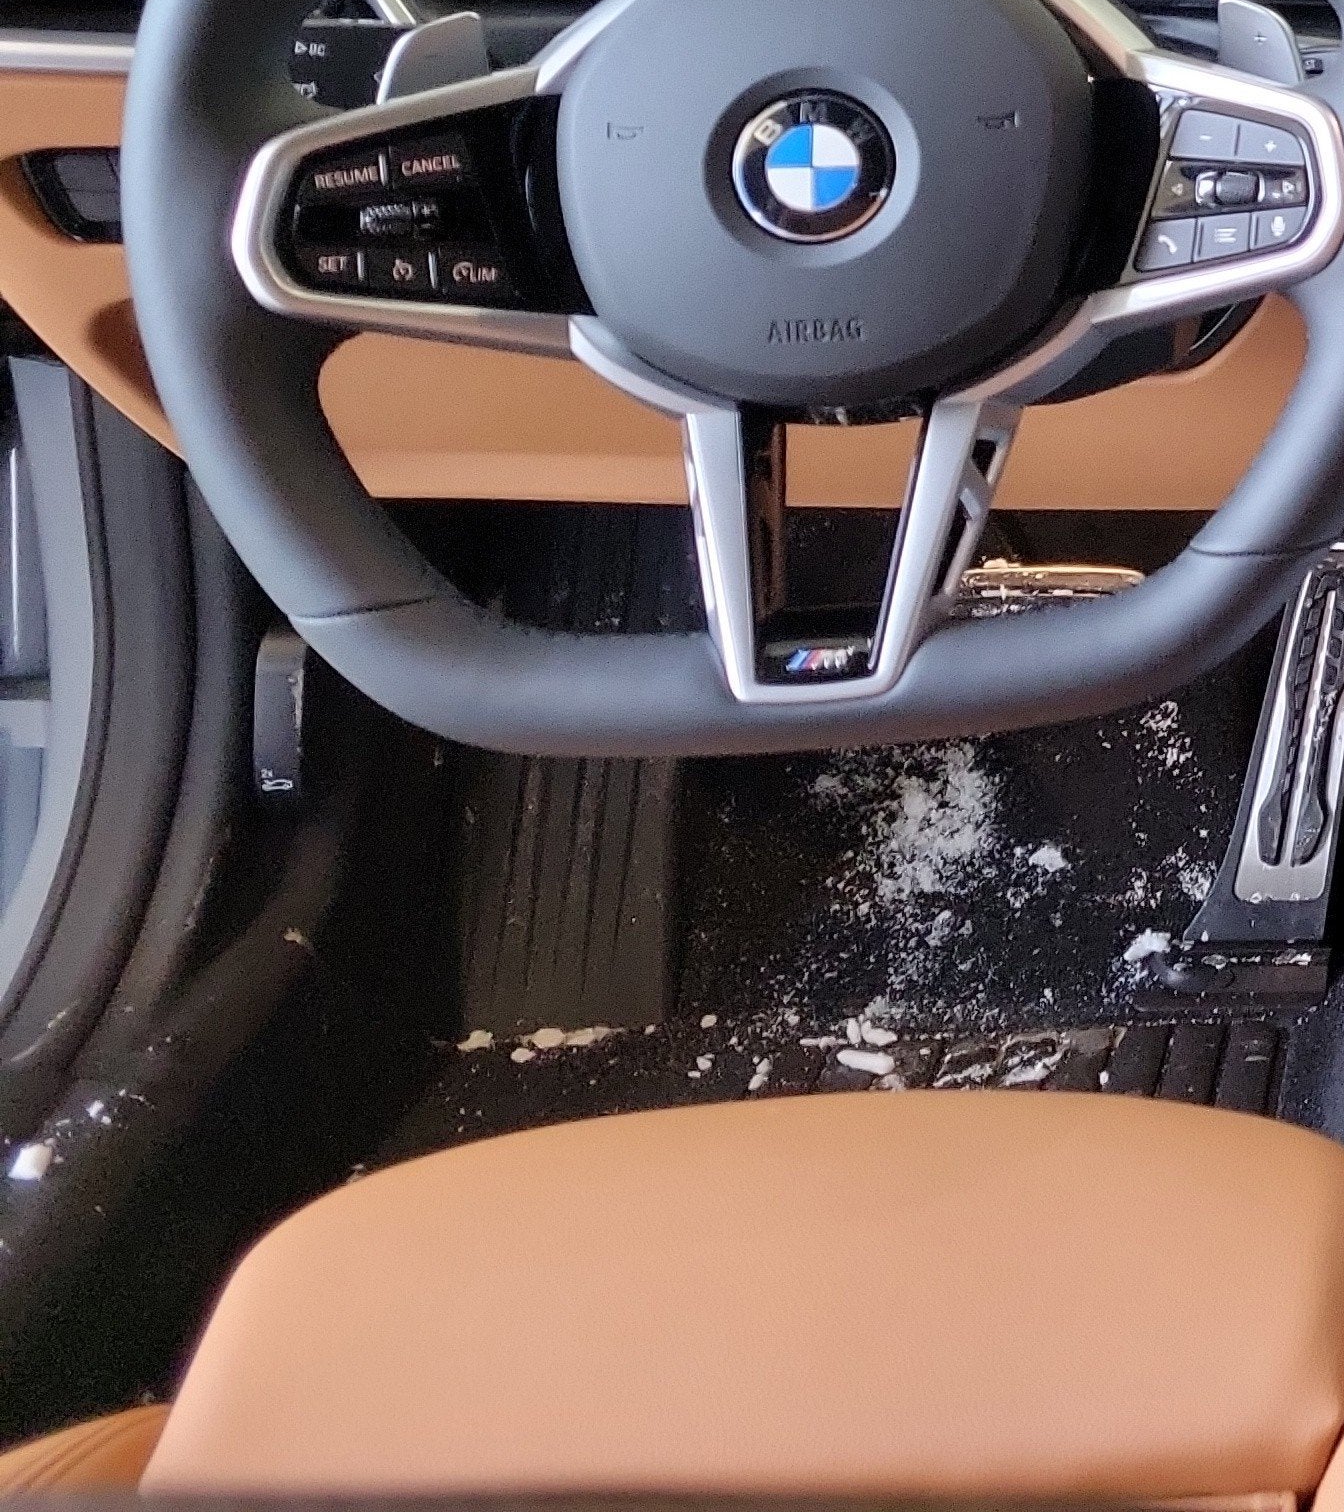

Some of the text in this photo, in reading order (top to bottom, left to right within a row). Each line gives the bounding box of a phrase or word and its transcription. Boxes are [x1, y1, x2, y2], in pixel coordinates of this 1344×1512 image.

[314, 153, 460, 189] RESUME CANCEL
[317, 255, 347, 274] SET
[767, 317, 865, 344] AIRBAG
